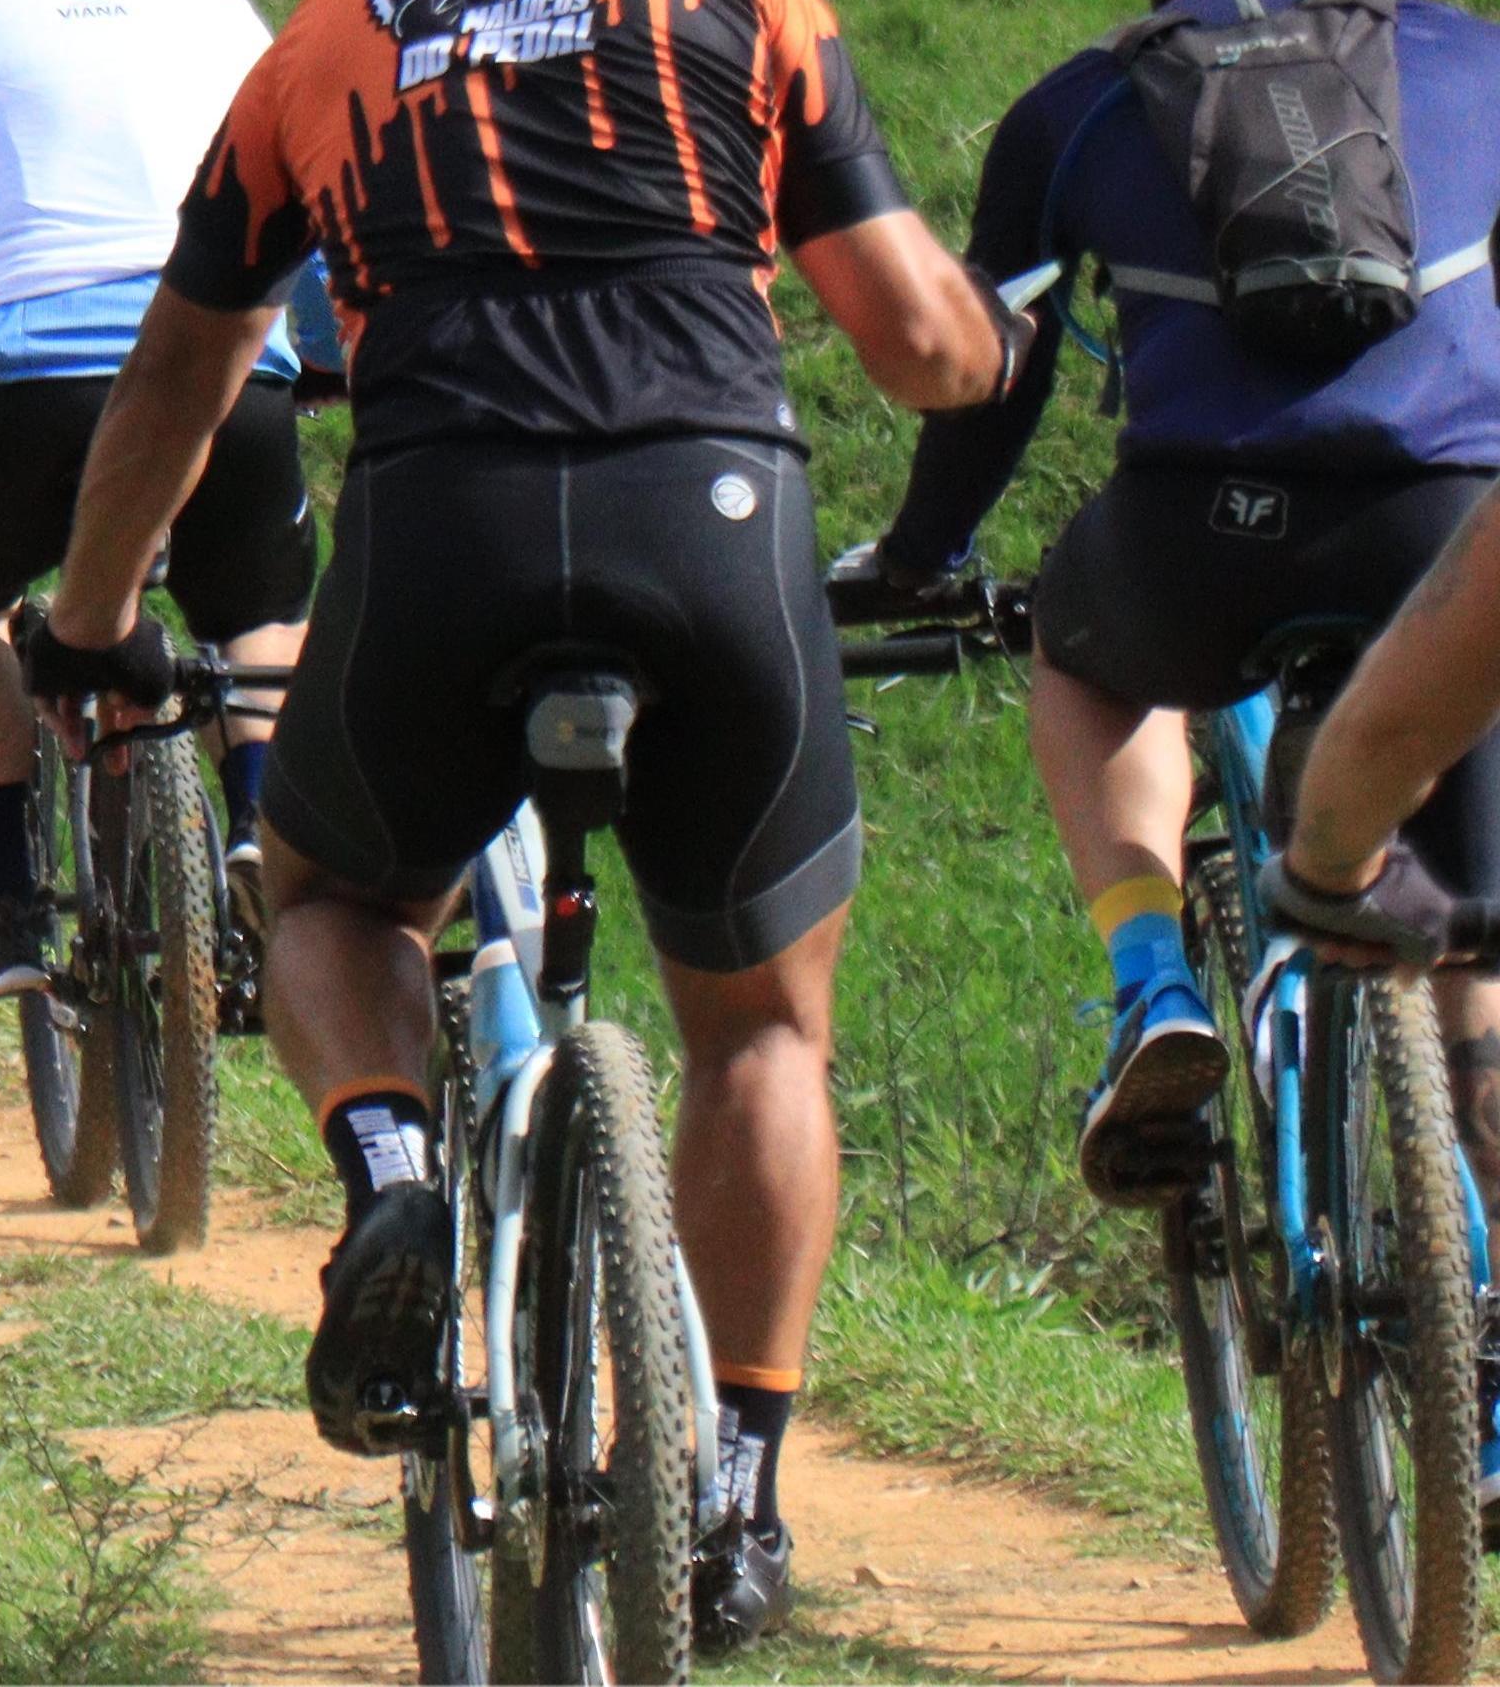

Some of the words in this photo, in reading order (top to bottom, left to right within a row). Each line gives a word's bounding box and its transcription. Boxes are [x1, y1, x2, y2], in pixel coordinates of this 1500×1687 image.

[56, 5, 128, 18] VIANA
[399, 35, 455, 90] DO
[469, 11, 594, 65] PEDAL
